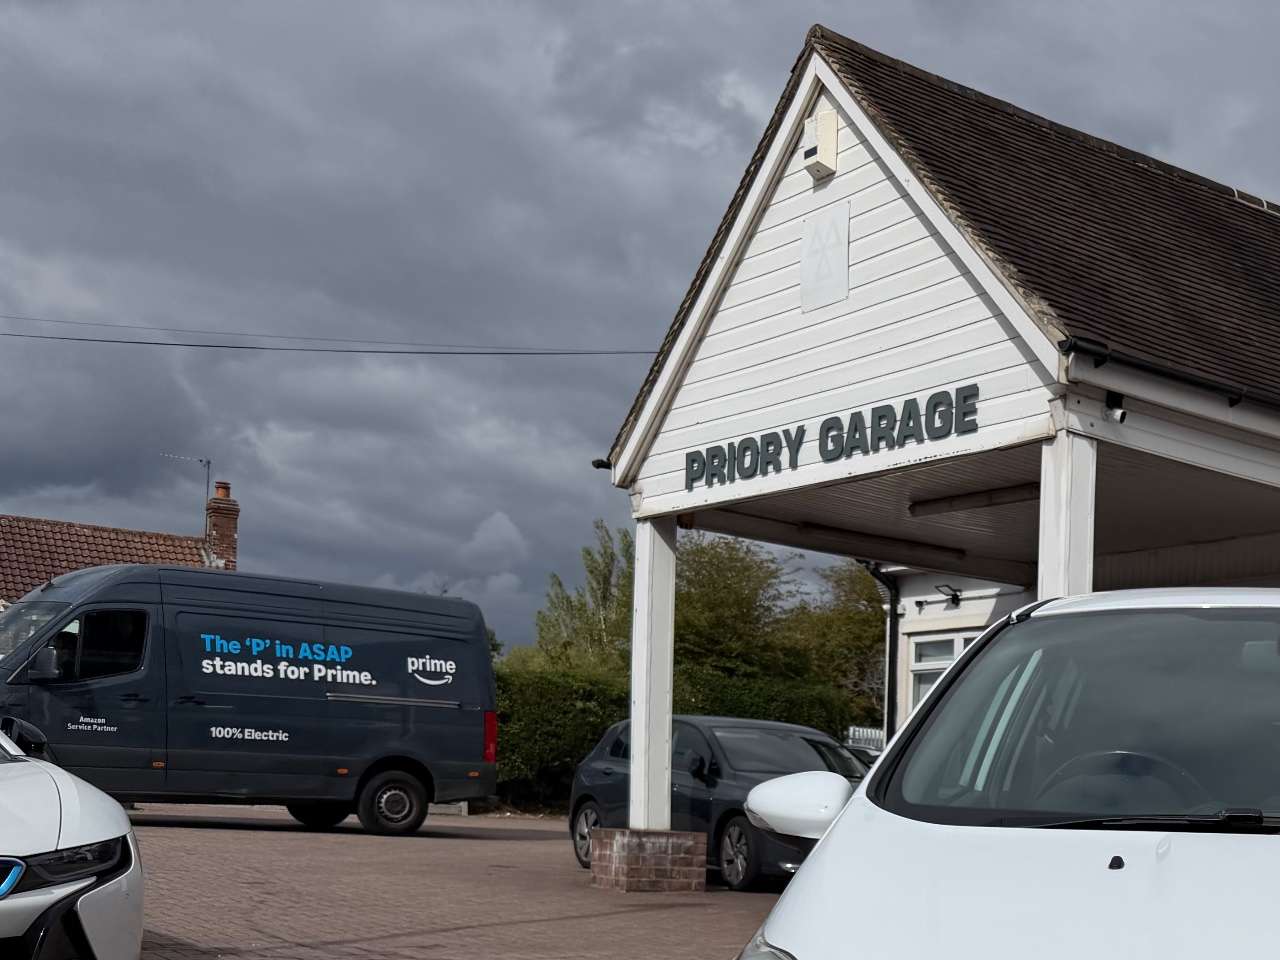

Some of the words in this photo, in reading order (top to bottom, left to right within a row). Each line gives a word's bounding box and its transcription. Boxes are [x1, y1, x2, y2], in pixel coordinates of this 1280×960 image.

[685, 424, 806, 492] PRIORY
[818, 383, 979, 463] GARAGE
[200, 633, 241, 654] The
[275, 640, 294, 659] in
[298, 642, 353, 663] ASAP
[201, 656, 274, 678] stands
[277, 661, 310, 680] for
[313, 664, 377, 685] Prime.
[407, 654, 457, 673] prime
[67, 723, 91, 731] Service
[92, 724, 118, 732] Partner
[79, 716, 106, 724] Amazon
[210, 726, 243, 739] 100%
[244, 728, 289, 741] Electric
